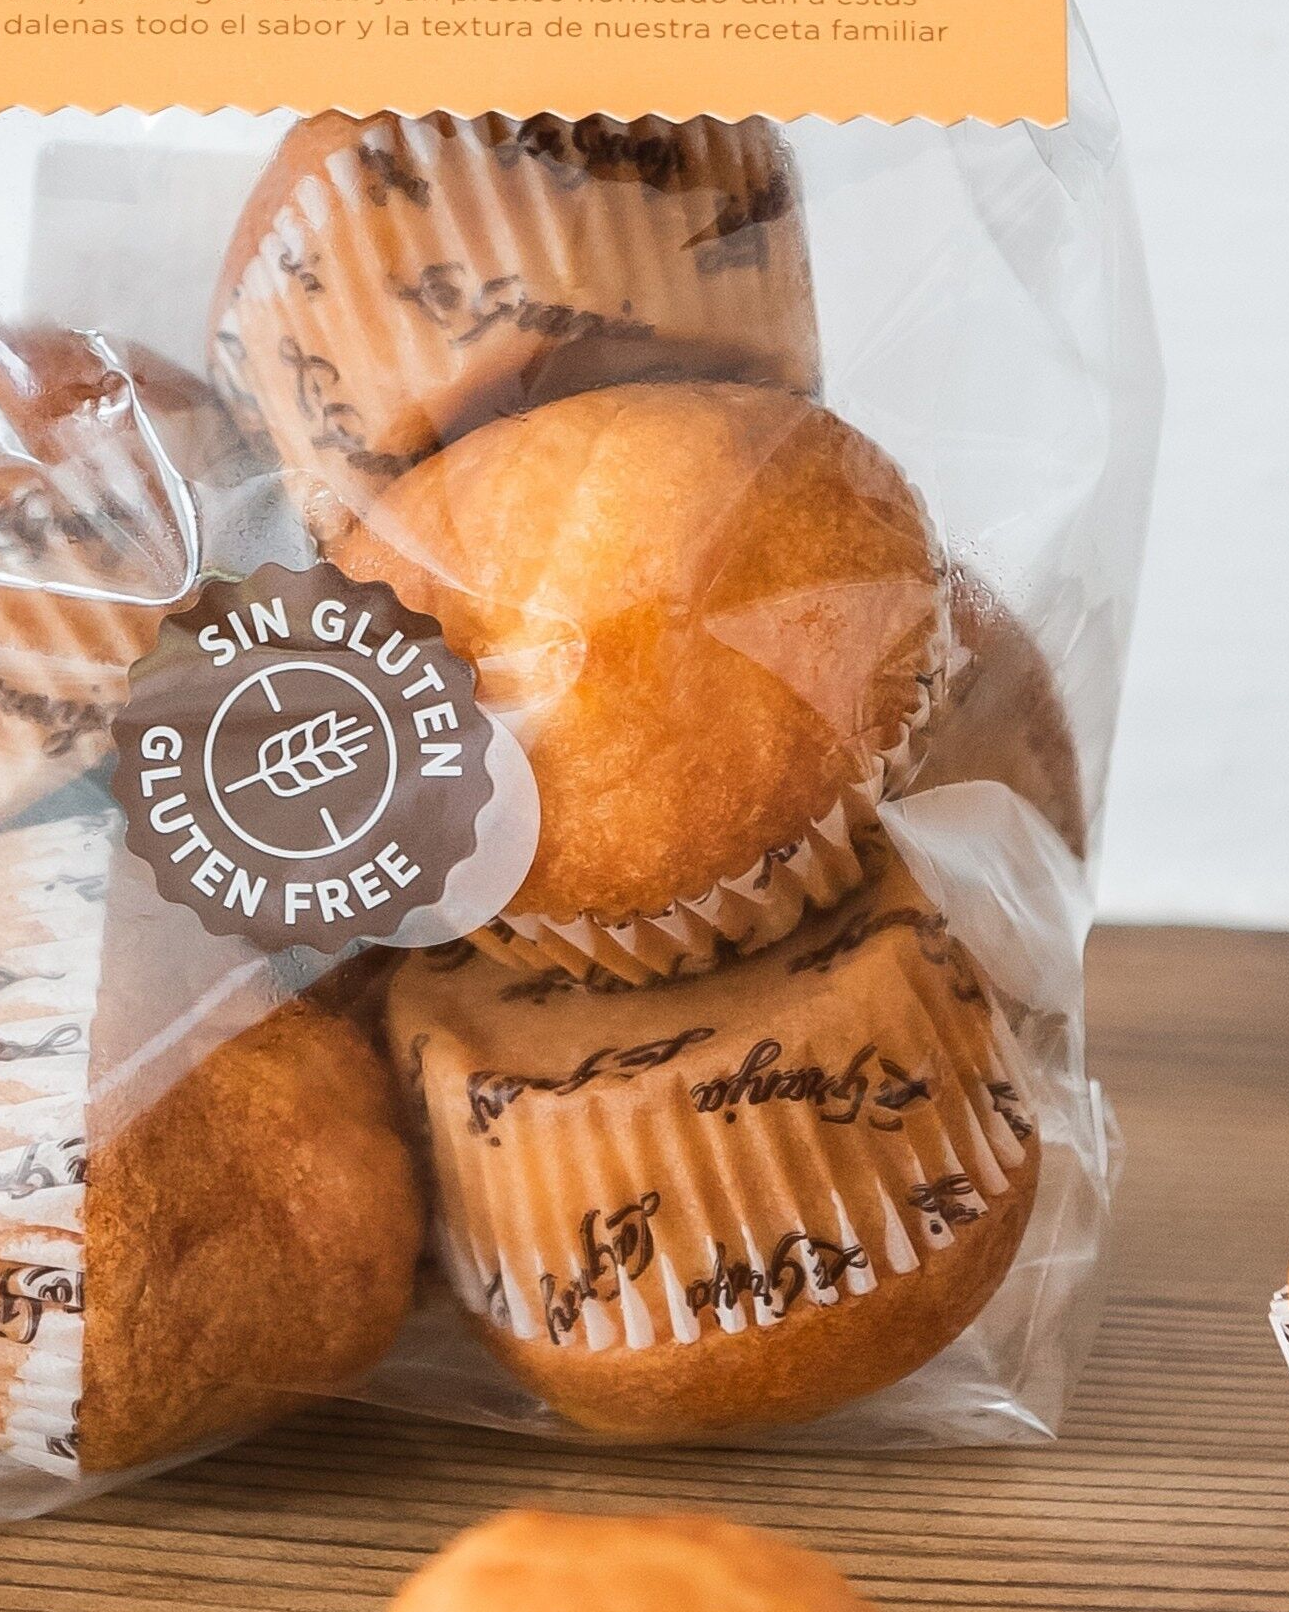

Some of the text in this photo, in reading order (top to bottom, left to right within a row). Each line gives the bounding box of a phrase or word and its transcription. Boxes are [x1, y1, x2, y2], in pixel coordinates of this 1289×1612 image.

[135, 14, 209, 35] todo
[220, 14, 245, 35] el
[257, 14, 346, 36] sabor
[357, 20, 374, 40] y
[386, 15, 409, 37] la
[422, 16, 533, 38] textura
[544, 16, 583, 38] de
[594, 19, 710, 39] nuestra
[722, 20, 820, 41] receta
[831, 18, 949, 43] familiar
[197, 597, 463, 778] SIN GLUTEN
[140, 725, 422, 925] GLUTEN FREE
[689, 1038, 877, 1125] Granja
